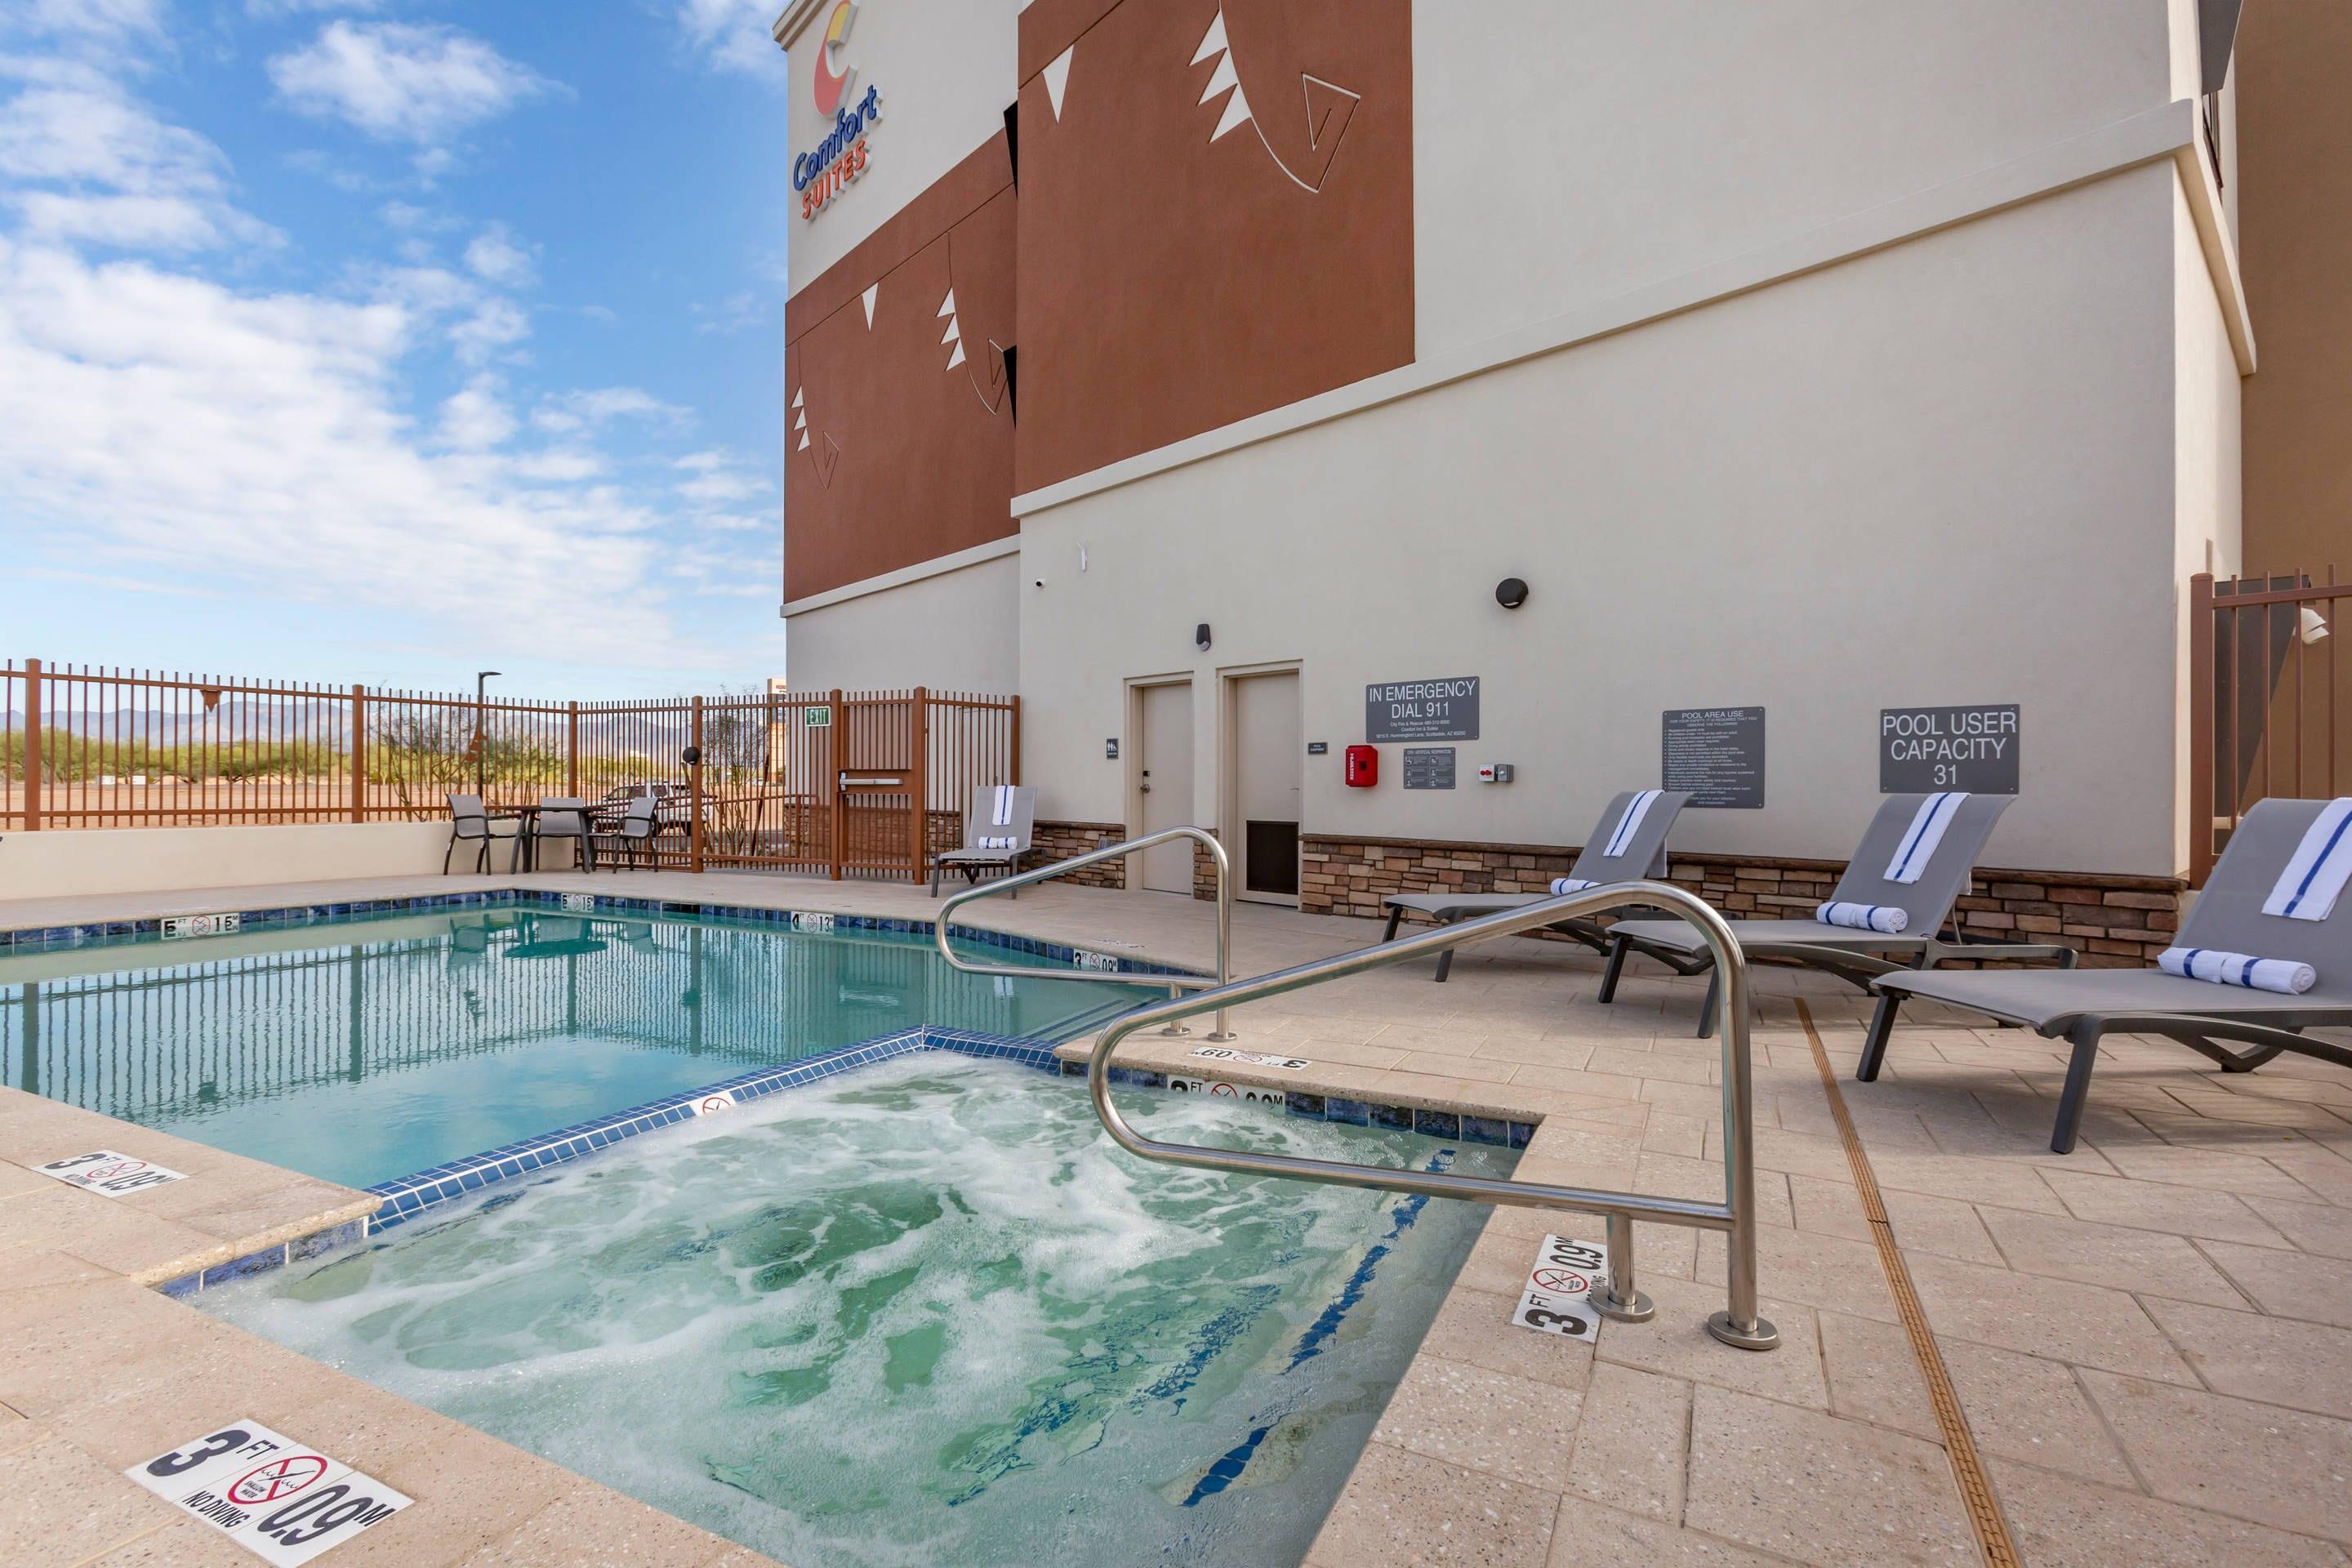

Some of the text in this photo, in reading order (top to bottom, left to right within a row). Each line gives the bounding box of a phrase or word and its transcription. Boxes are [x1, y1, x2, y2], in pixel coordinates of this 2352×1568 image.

[793, 84, 878, 192] Comfort
[802, 139, 866, 220] SUITES
[1369, 680, 1476, 702] IN EMERGENCY
[809, 709, 826, 724] EXIT
[1392, 702, 1450, 719] DIAL 911
[1883, 711, 2016, 736] POOL USER
[1891, 737, 2007, 760] CAPACITY
[1934, 764, 1956, 785] 31
[1191, 1081, 1203, 1093] FT
[43, 1153, 107, 1169] 3
[1524, 1294, 1588, 1335] 3 FT
[146, 1429, 280, 1477] 3 FT
[181, 1490, 251, 1528] NO DIVING
